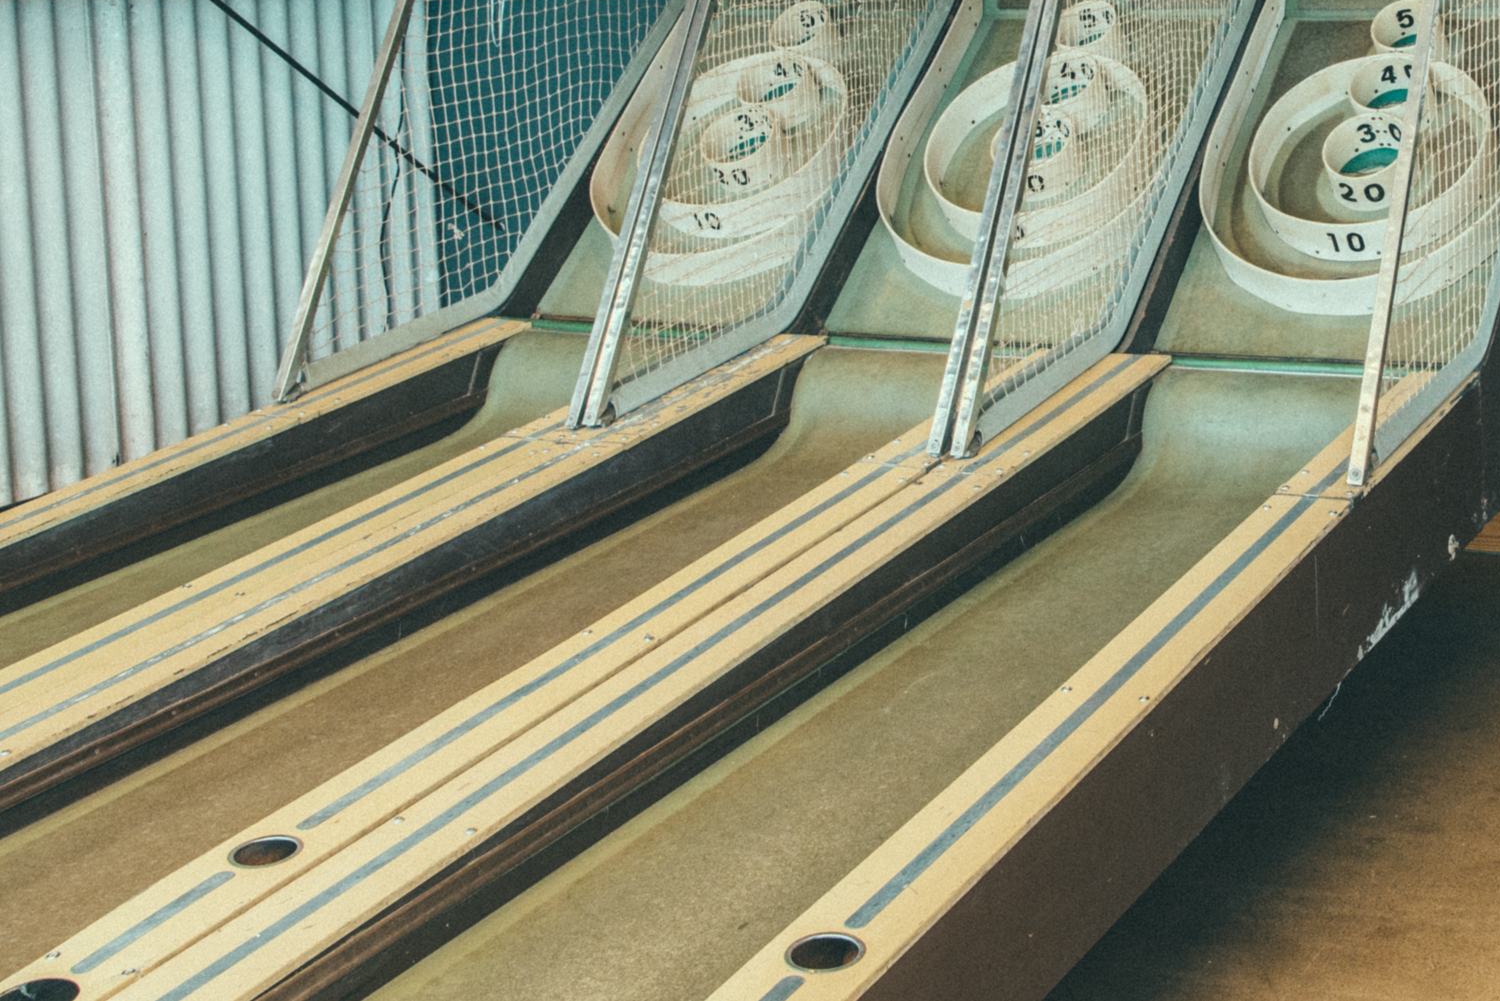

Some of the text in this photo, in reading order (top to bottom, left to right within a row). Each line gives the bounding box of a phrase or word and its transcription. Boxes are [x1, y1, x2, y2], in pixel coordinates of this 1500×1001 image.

[1396, 8, 1415, 28] 5
[1356, 123, 1402, 143] 30
[1338, 182, 1386, 203] 20
[693, 212, 721, 231] 10
[1327, 232, 1366, 253] 10
